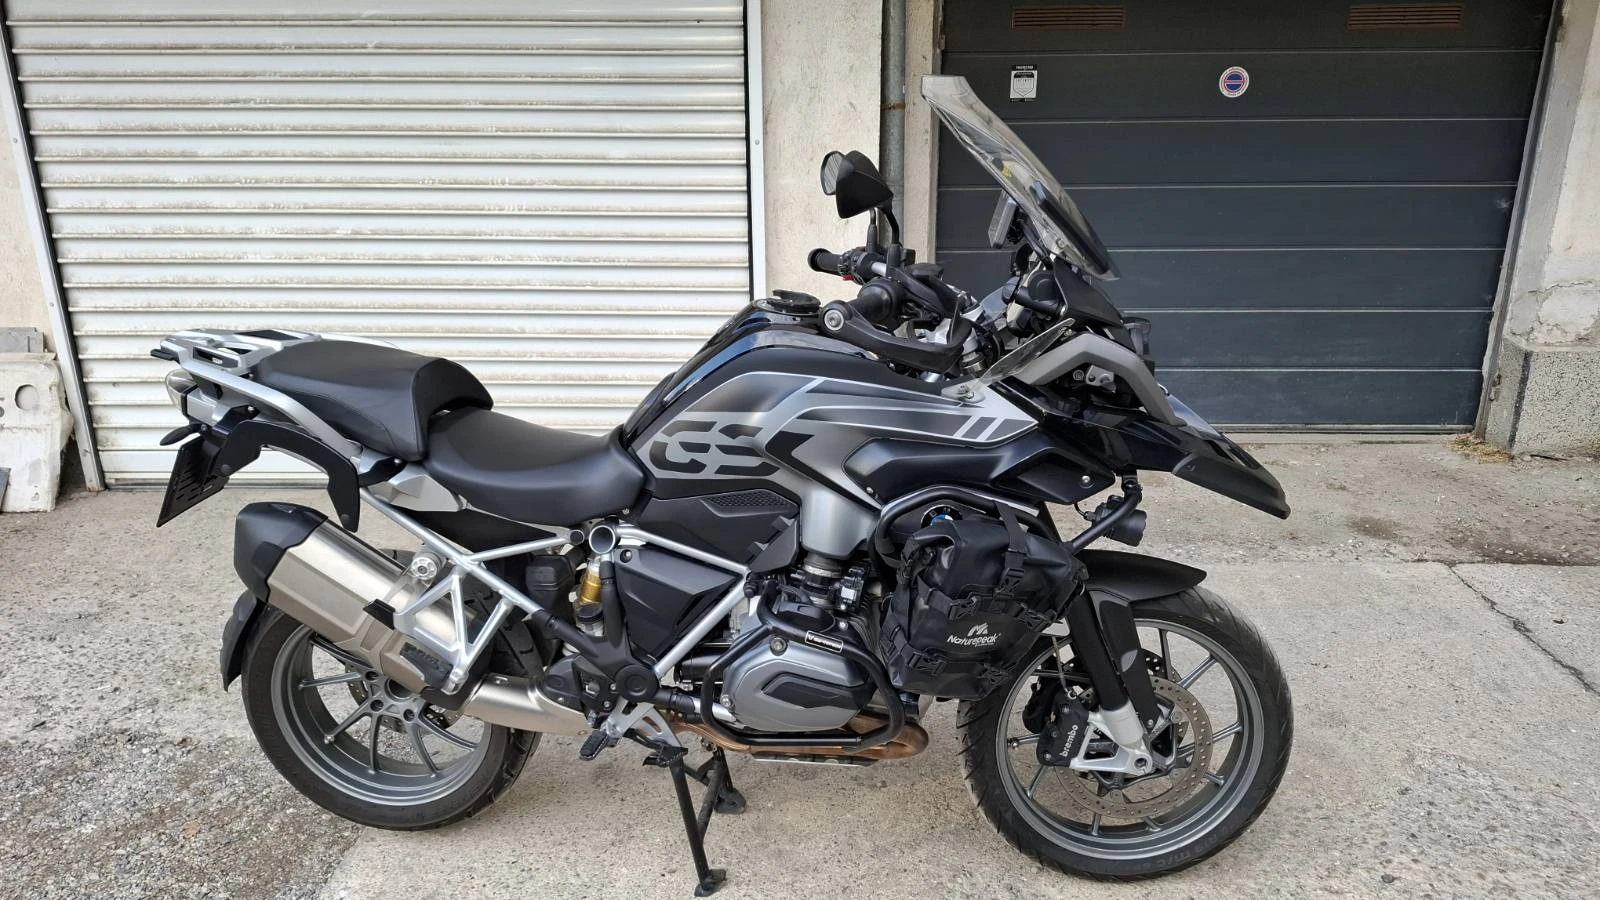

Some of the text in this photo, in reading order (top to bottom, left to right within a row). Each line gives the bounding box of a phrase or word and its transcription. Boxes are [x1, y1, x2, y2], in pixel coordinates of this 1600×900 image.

[649, 420, 780, 476] GS
[946, 633, 999, 648] Naturepeak
[1059, 724, 1078, 757] brembo
